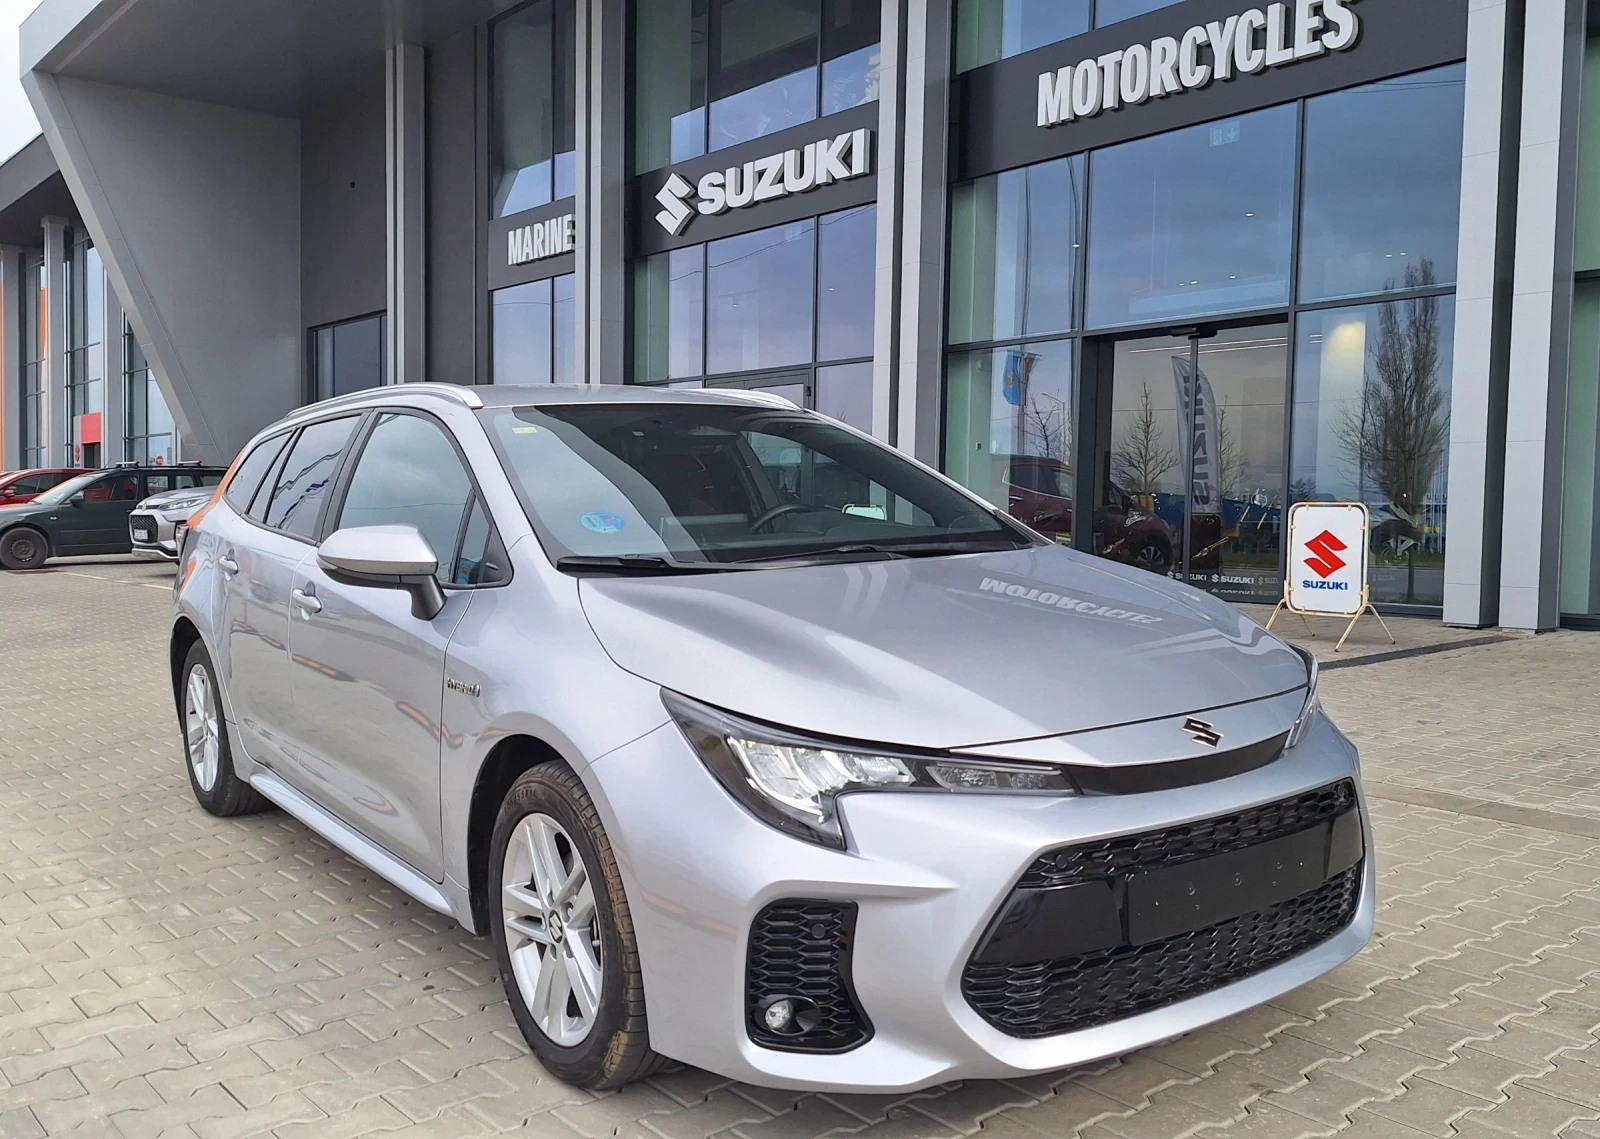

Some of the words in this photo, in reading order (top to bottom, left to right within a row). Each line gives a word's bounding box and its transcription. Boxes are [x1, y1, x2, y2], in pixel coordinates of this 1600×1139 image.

[1037, 0, 1357, 127] MOTORCYCLES
[697, 128, 870, 215] SUZUKI
[508, 213, 573, 265] MARINE
[1220, 575, 1254, 584] SUZUKI
[1302, 580, 1348, 590] SUZUKI
